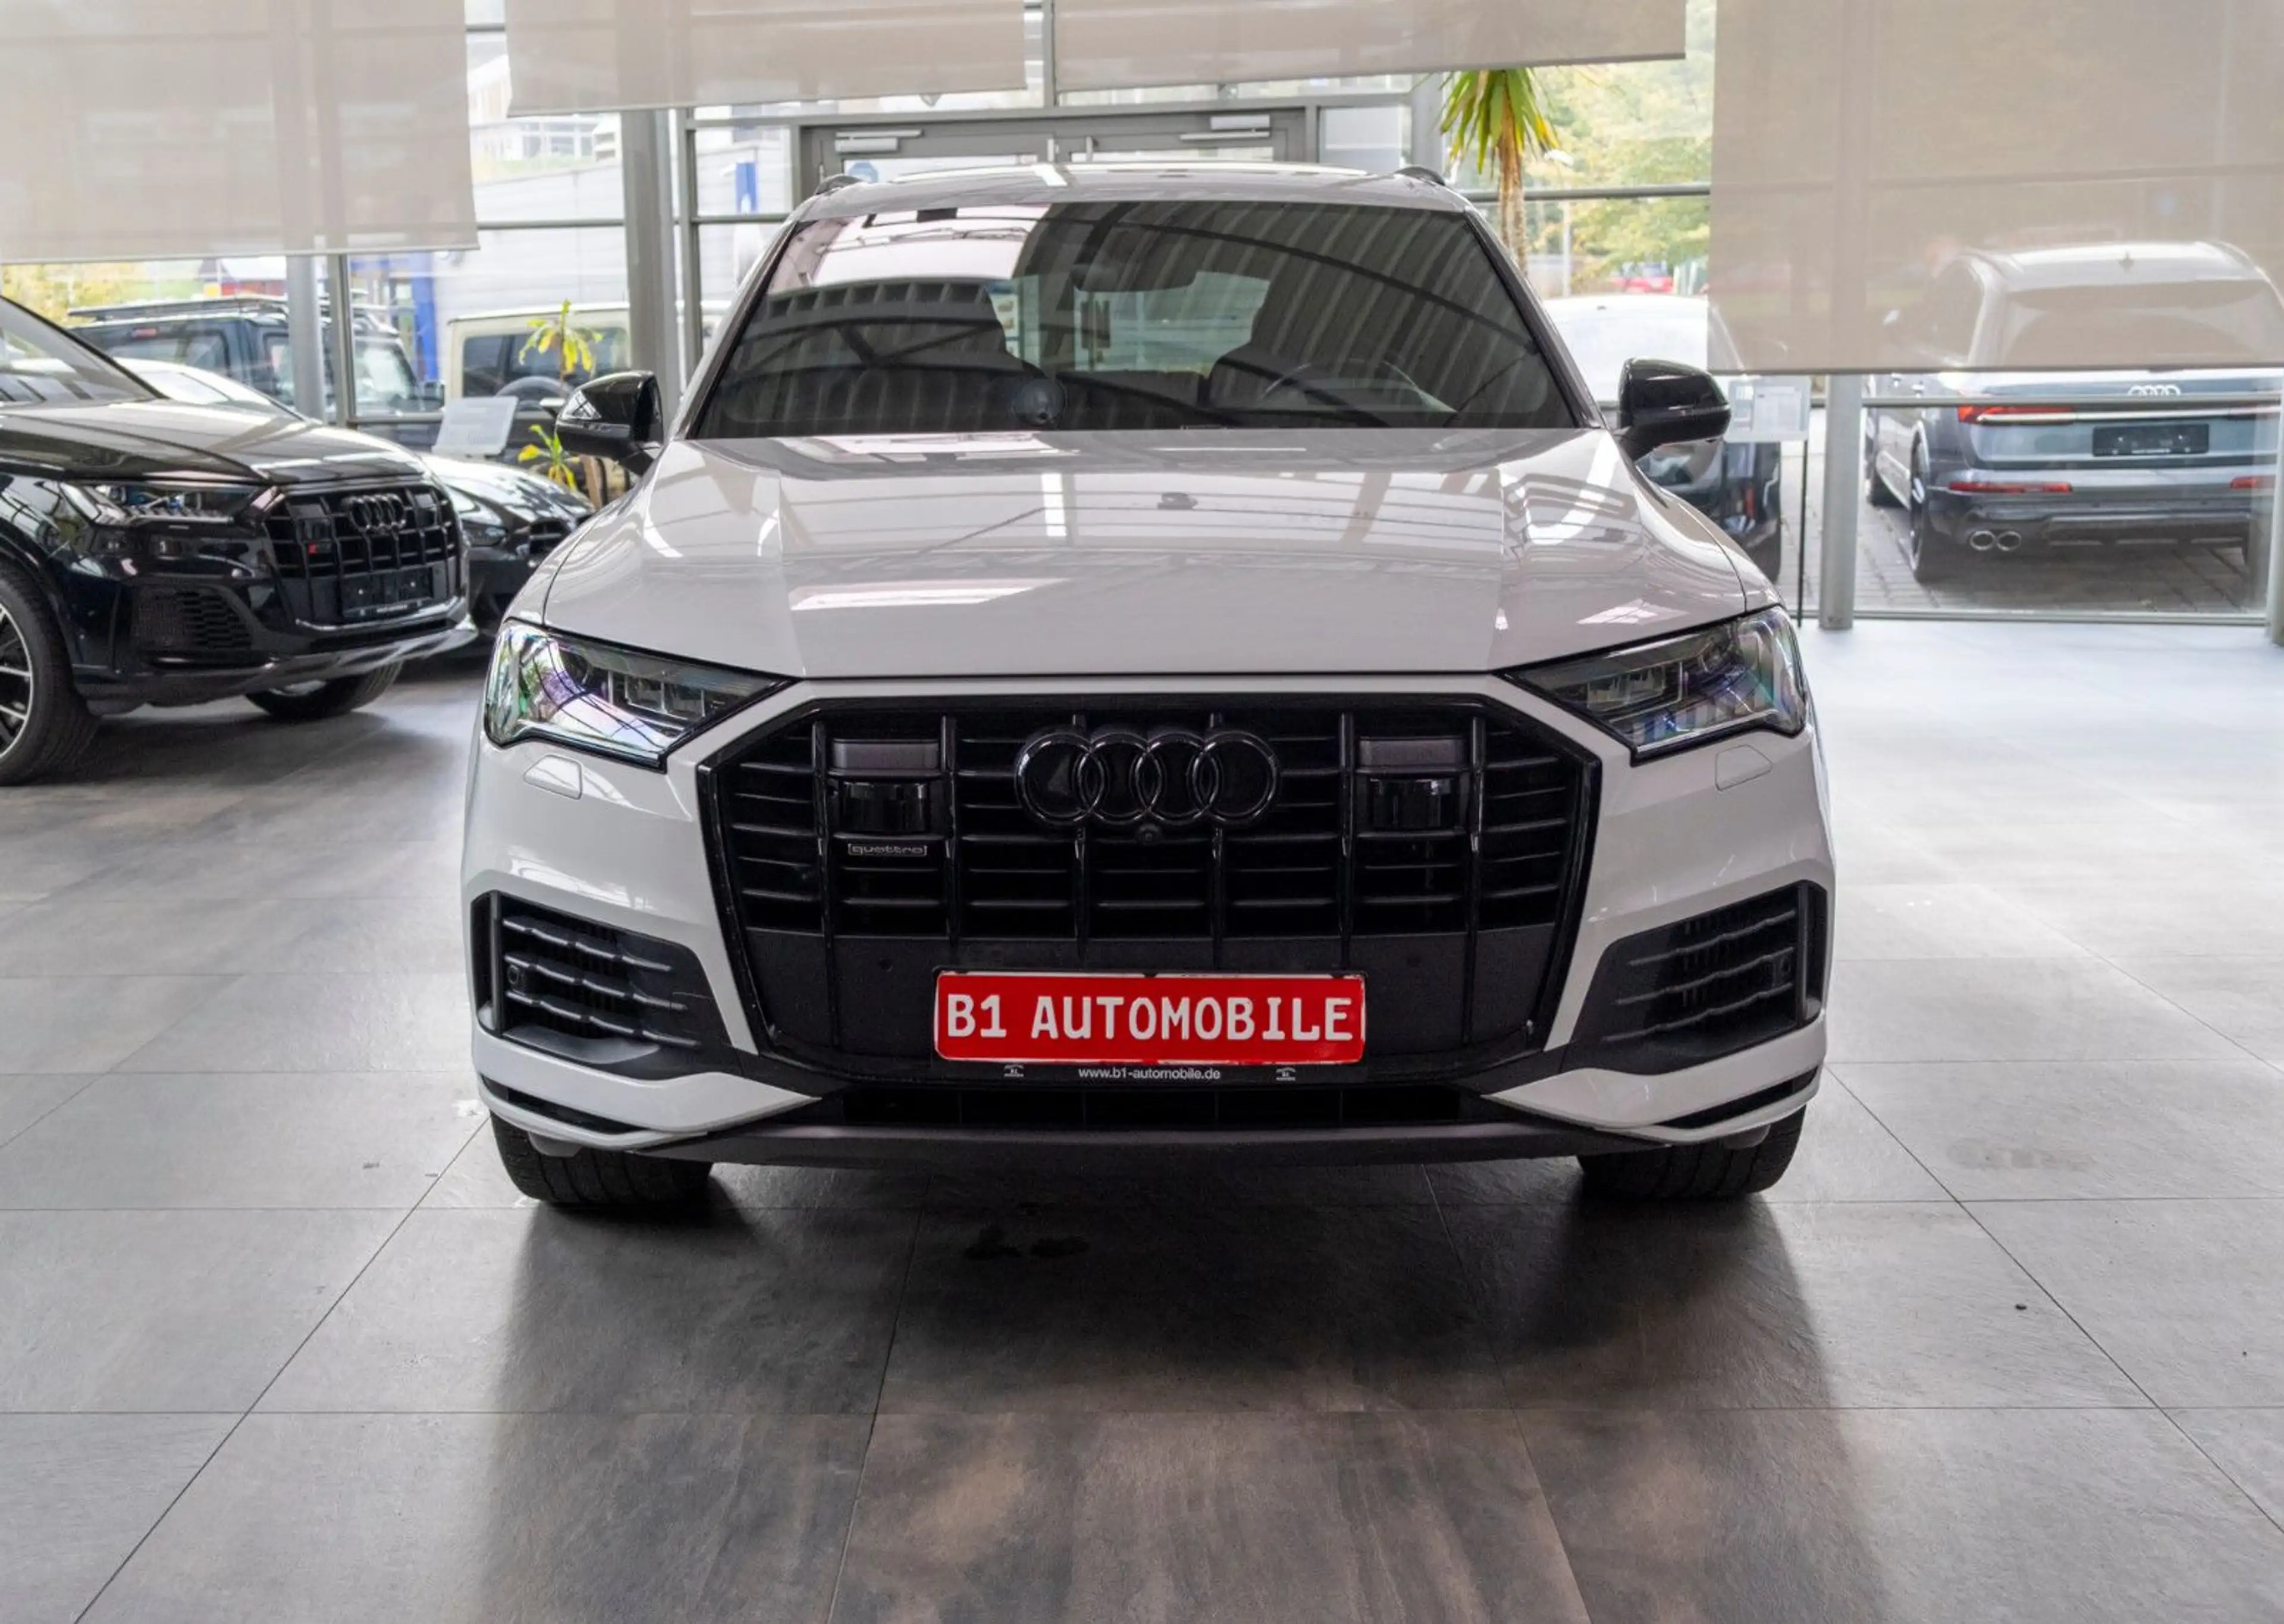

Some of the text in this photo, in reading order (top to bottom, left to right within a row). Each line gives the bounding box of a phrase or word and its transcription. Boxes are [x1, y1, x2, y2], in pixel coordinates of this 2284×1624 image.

[947, 994, 1353, 1041] B1 AUTOMOBILE
[1078, 1067, 1221, 1080] www.b1-automobile.de
